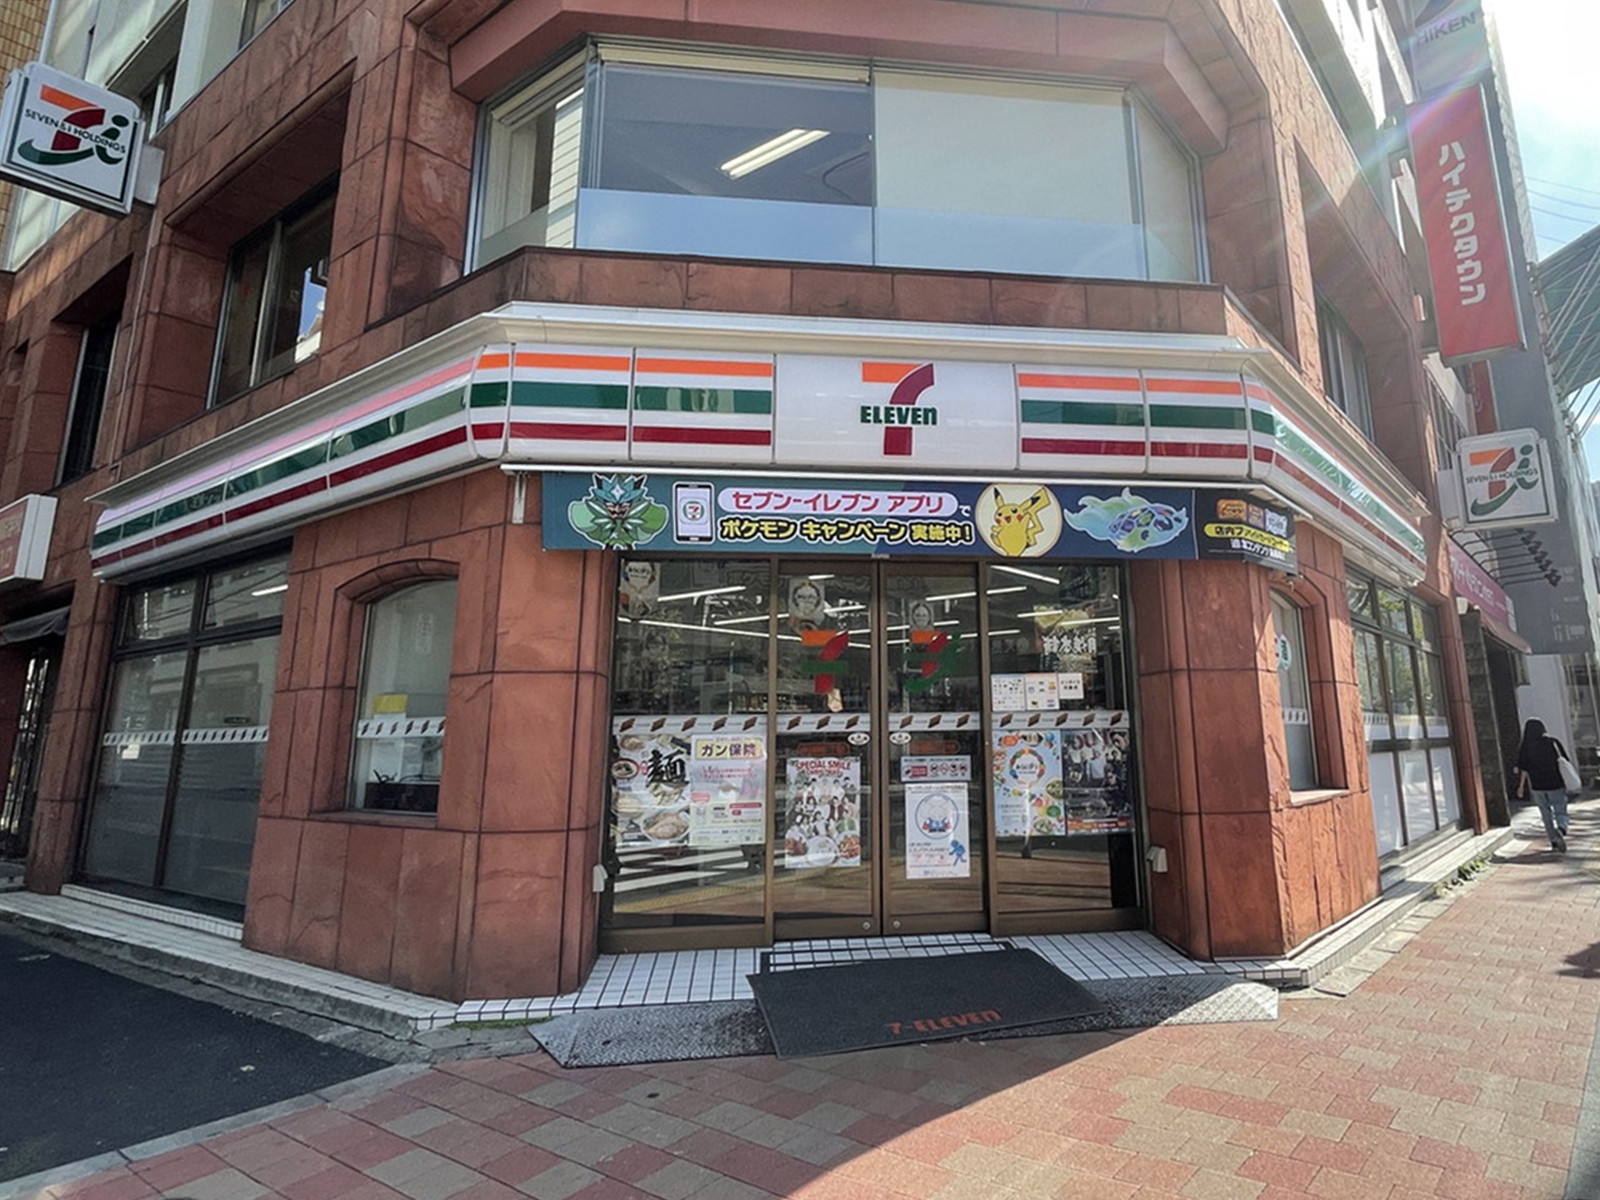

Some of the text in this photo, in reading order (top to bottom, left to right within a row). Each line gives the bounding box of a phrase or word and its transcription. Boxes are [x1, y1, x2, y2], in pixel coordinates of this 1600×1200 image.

[25, 108, 58, 128] SEVEN
[73, 127, 127, 154] HOLDINGS
[1439, 141, 1486, 306] ハイテクタウン
[1465, 474, 1489, 484] SEVEN
[1499, 467, 1538, 479] HOLDINGS
[732, 491, 972, 518] セブン-イレブン アプリ で
[721, 518, 796, 540] ポケモン
[802, 521, 907, 542] キャンペーン
